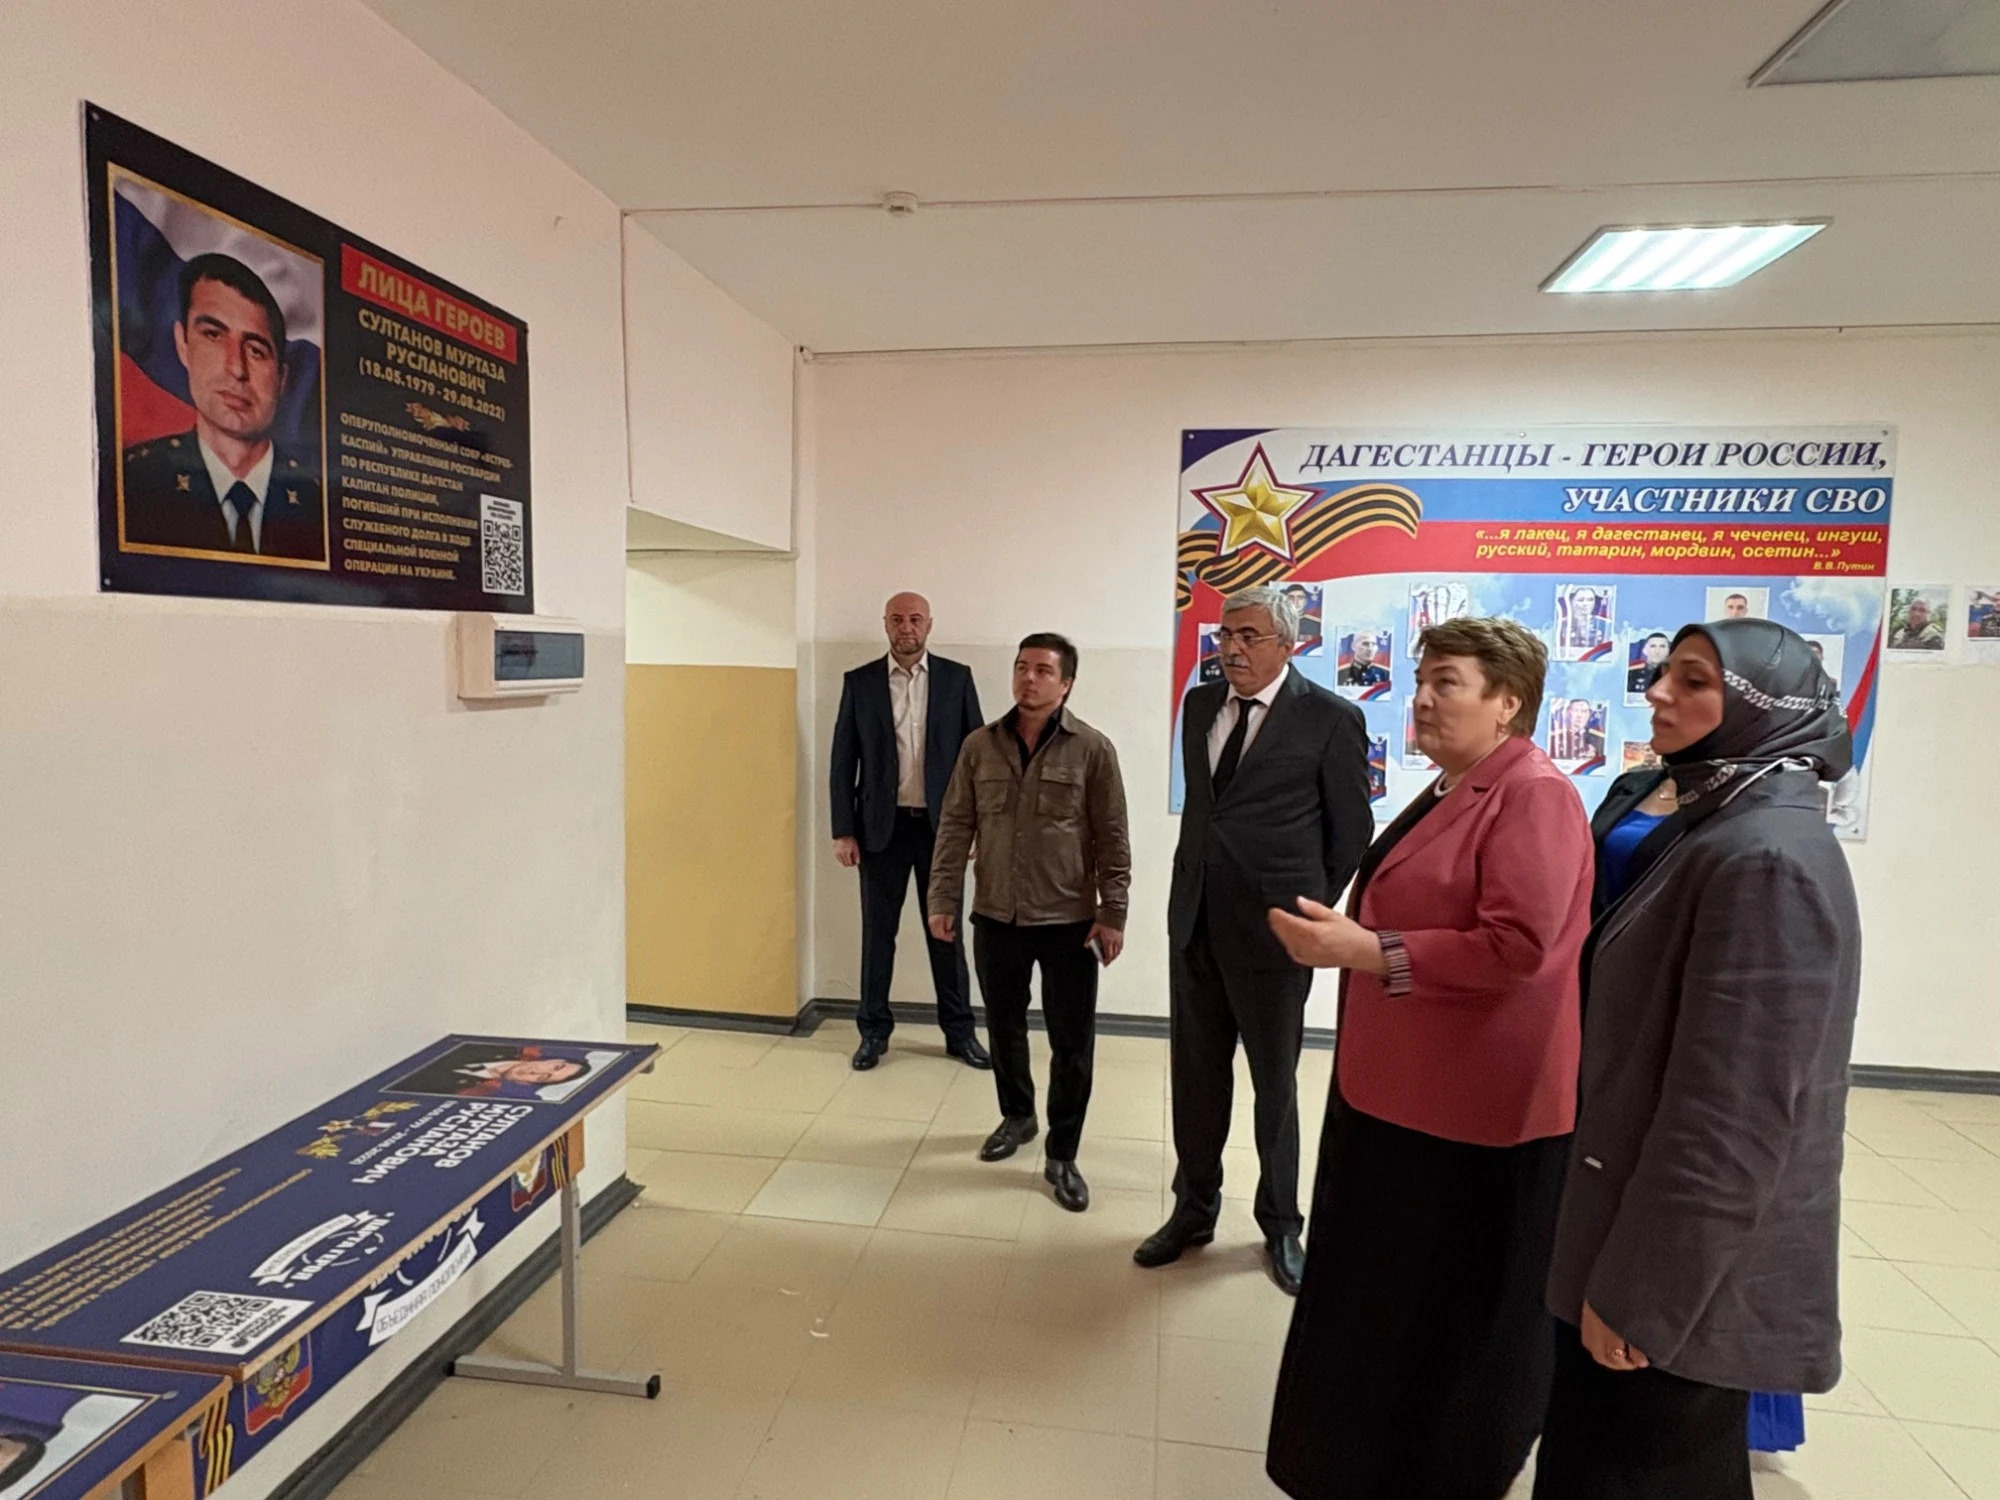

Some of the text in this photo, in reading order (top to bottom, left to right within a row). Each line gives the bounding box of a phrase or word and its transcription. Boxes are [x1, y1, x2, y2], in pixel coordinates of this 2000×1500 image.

[358, 261, 506, 350] ЛИЦА ГЕРОЕВ
[358, 308, 506, 383] СУЛТАНОВ МУРТАЗА
[386, 341, 486, 395] РУСЛАНОВИЧ
[1299, 444, 1553, 474] ДАГЕСТАНЦЫ
[1581, 442, 1710, 468] ГЕРОИ
[1715, 441, 1887, 470] РОССИИ,
[341, 454, 357, 468] ПО
[421, 474, 464, 492] ДАГЕСТАН
[341, 475, 390, 494] КАПИТАН
[341, 495, 400, 516] ПОГИБШИЙ
[401, 507, 421, 520] ПРИ
[1561, 486, 1887, 514] УЧАСТНИКИ СВО
[342, 517, 410, 538] СЛУЖЕБНОГО
[1513, 528, 1571, 543] лакец,
[1575, 528, 1588, 540] я
[1592, 526, 1708, 543] дагестанец,
[1713, 529, 1725, 541] я
[1730, 529, 1810, 543] чеченец,
[1816, 529, 1883, 545] ингуш,
[343, 538, 417, 557] СПЕЦИАЛЬНОЙ
[1475, 542, 1552, 558] русский,
[1556, 544, 1646, 559] татарин,
[1650, 543, 1736, 560] мордвин,
[344, 558, 399, 575] ОПЕРАЦИИ
[400, 564, 414, 576] НА
[352, 1102, 489, 1184] РУСЛАНОВИЧ
[419, 1103, 513, 1157] МУРТАЗА
[434, 1104, 534, 1168] СУЛТАНОВ
